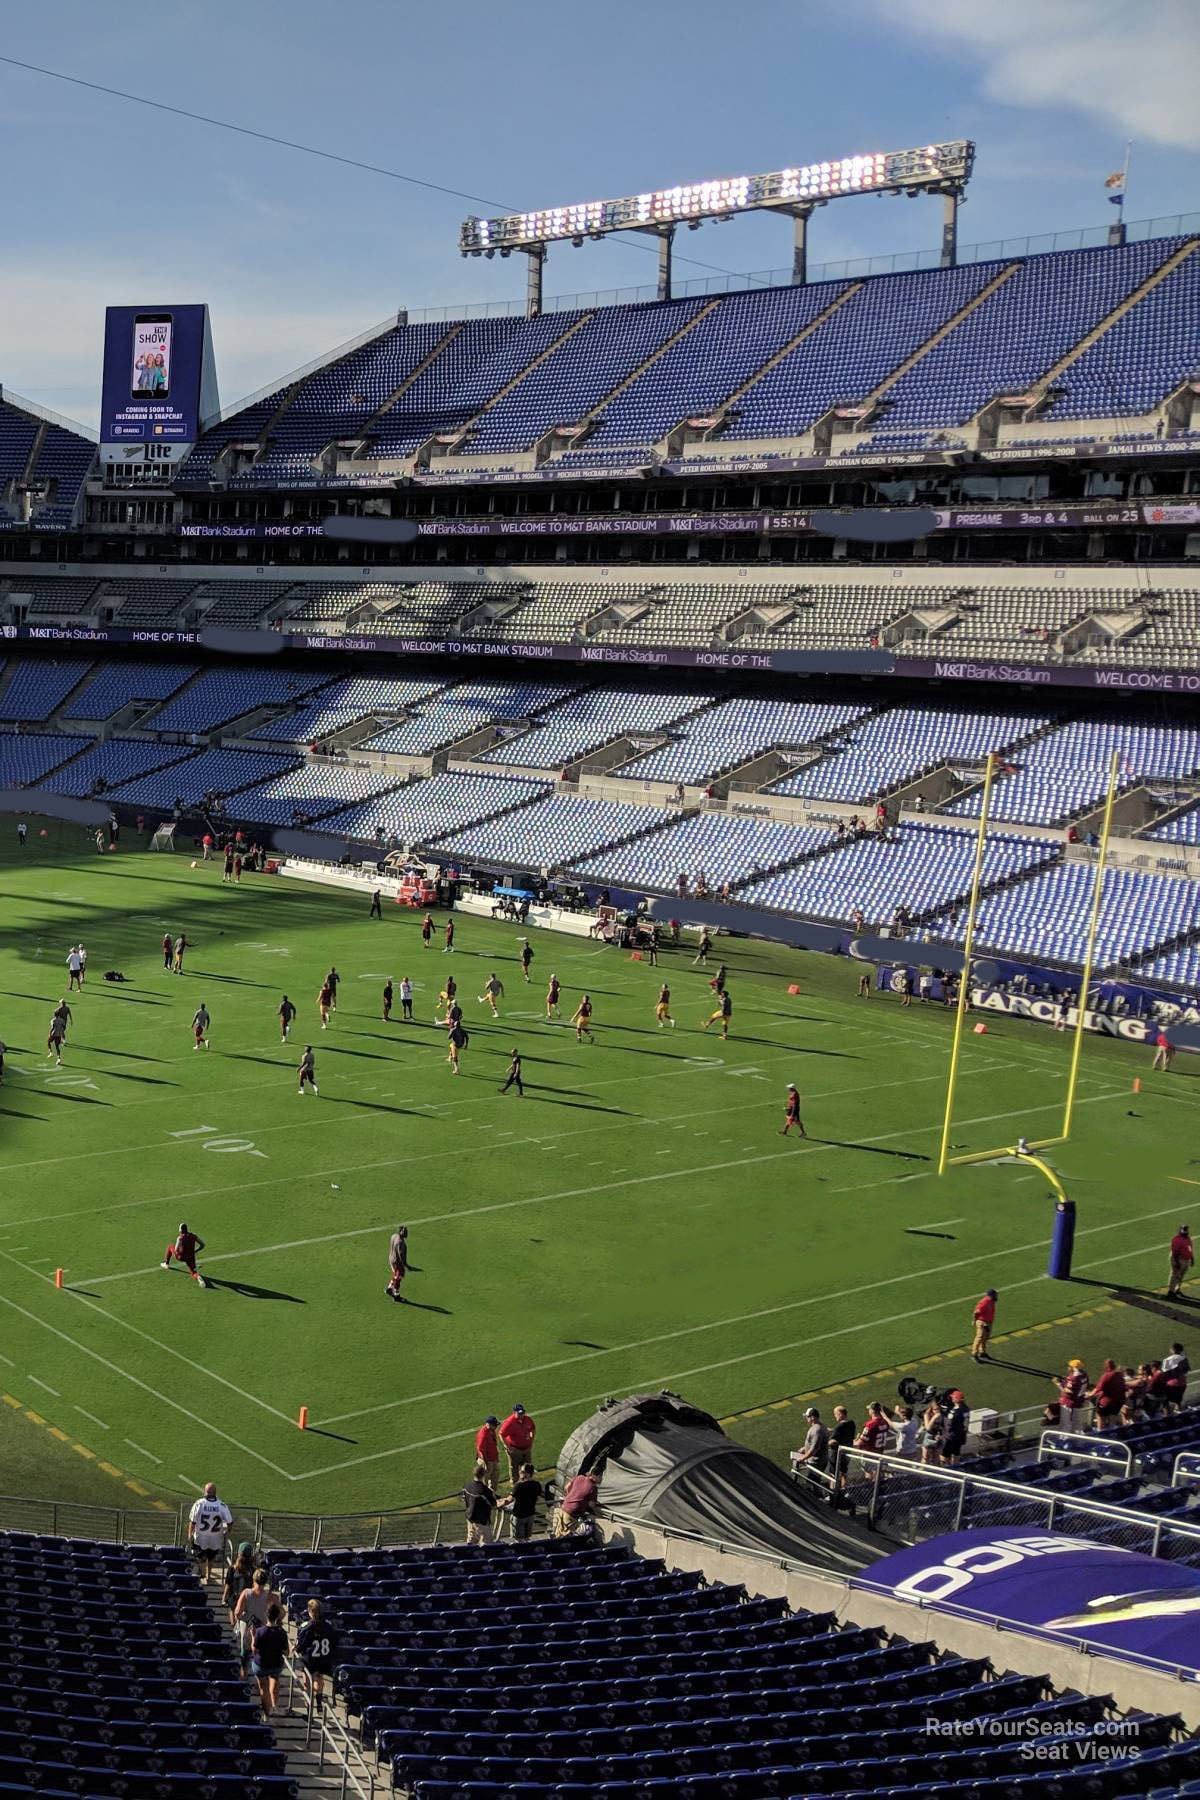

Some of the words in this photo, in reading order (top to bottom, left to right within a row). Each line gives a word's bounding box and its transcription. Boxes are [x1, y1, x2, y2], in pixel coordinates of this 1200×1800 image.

[139, 333, 167, 344] SHOW
[125, 406, 148, 414] COMING
[166, 406, 174, 414] TO
[143, 443, 172, 462] Lite
[1003, 449, 1032, 458] STOVER
[1107, 445, 1134, 455] JAMAL
[1136, 443, 1163, 453] LEWIS
[824, 458, 860, 467] JONATHAN
[772, 517, 807, 528] 55:14
[955, 513, 1003, 526] PREGAME
[1020, 513, 1042, 525] 3RD
[1044, 512, 1056, 524] &
[1057, 512, 1068, 523] 4
[1083, 514, 1105, 523] BALL
[1106, 514, 1119, 522] ON
[1121, 511, 1138, 522] 25
[417, 524, 439, 535] M&T
[438, 524, 457, 535] Bank
[457, 523, 490, 535] Stadium
[501, 522, 546, 533] WELCOME
[548, 522, 562, 532] TO
[564, 521, 584, 532] M&T
[586, 521, 612, 531] BANK
[614, 520, 657, 531] STADIUM
[670, 518, 694, 531] M&T
[694, 518, 718, 530] Bank
[718, 517, 758, 529] Stadium
[181, 526, 201, 536] M&T
[201, 526, 222, 536] Bank
[222, 526, 256, 536] Stadium
[264, 526, 291, 536] HOME
[292, 526, 305, 535] OF
[307, 526, 323, 535] THE
[29, 628, 52, 638] M&T
[52, 628, 73, 639] Bank
[73, 629, 108, 640] Stadium
[133, 632, 159, 641] HOME
[161, 632, 175, 642] OF
[177, 633, 195, 643] THE
[307, 636, 325, 648] M&T
[326, 637, 345, 648] Bank
[345, 638, 376, 650] Stadium
[401, 640, 445, 652] WELCOME
[447, 642, 460, 653] TO
[462, 643, 482, 654] M&T
[484, 643, 510, 654] BANK
[511, 644, 553, 657] STADIUM
[581, 649, 605, 661] M&T
[605, 649, 628, 661] Bank
[628, 650, 668, 663] Stadium
[696, 653, 729, 665] HOME
[732, 654, 749, 666] OF
[751, 655, 772, 667] THE
[935, 662, 967, 678] M&T
[966, 664, 998, 680] Bank
[998, 666, 1051, 682] Stadium
[1095, 671, 1172, 688] WELCOME
[1178, 675, 1200, 689] TO
[199, 1514, 221, 1533] 52
[311, 1638, 330, 1657] 28
